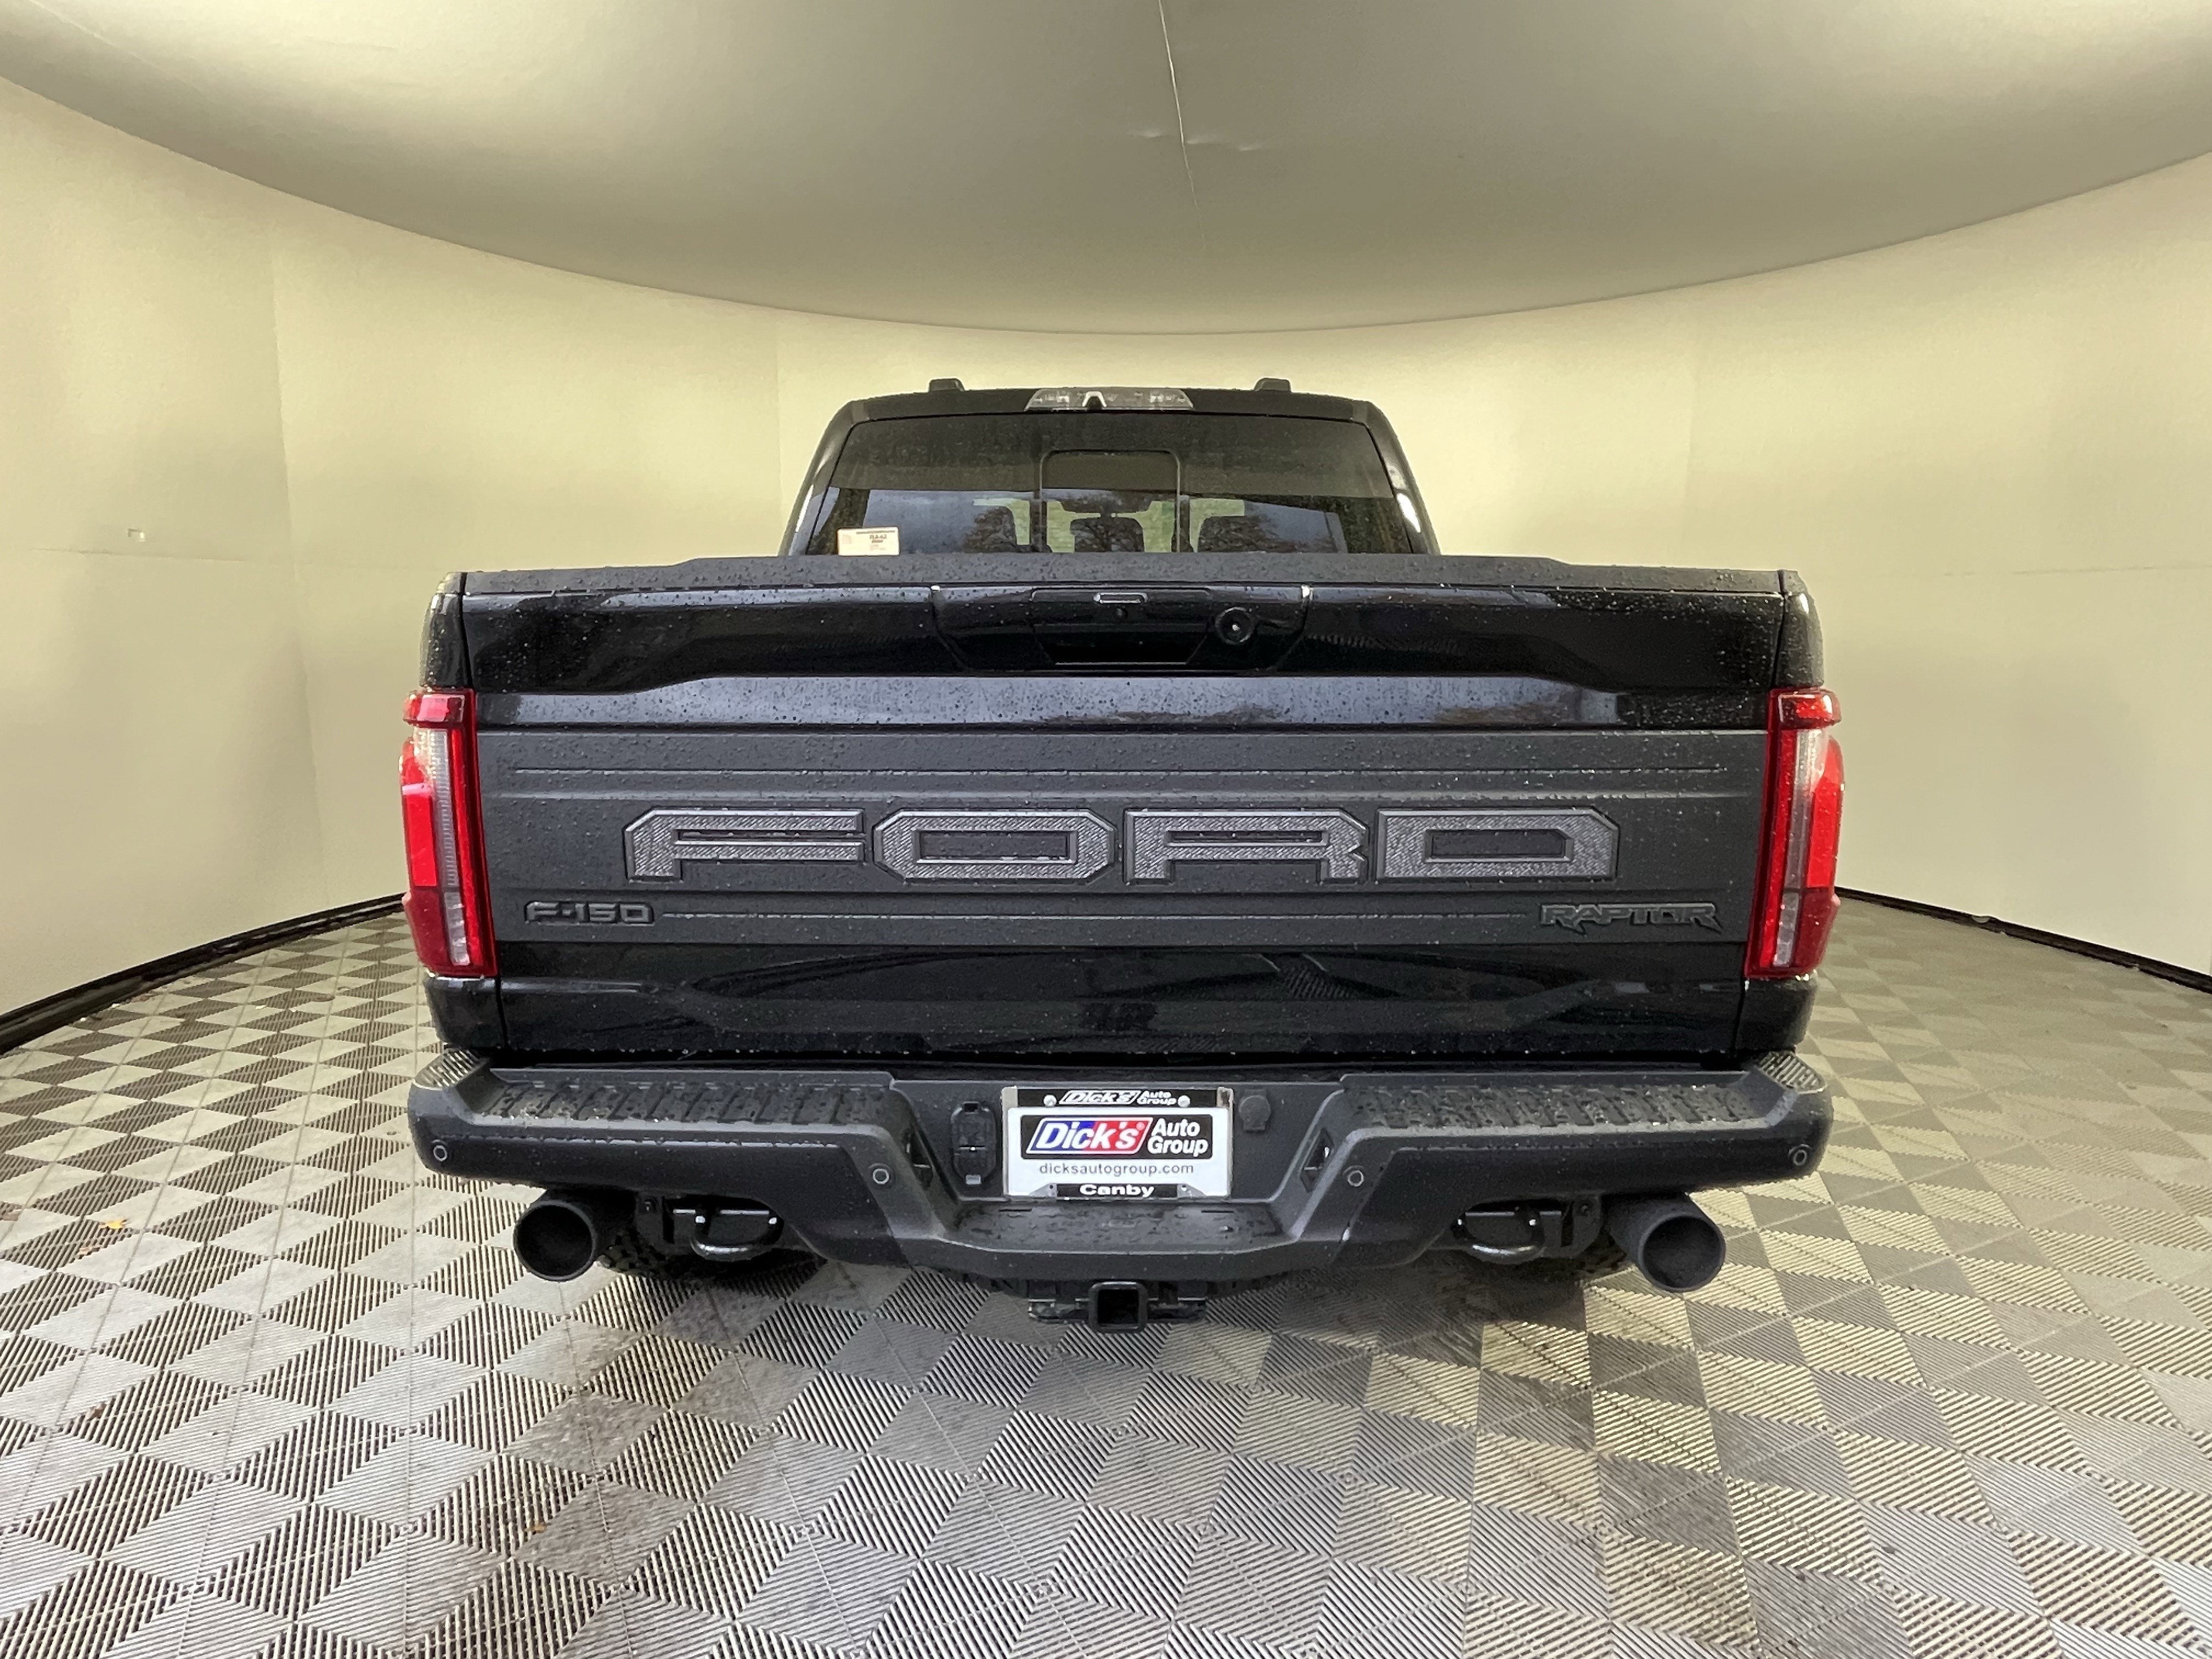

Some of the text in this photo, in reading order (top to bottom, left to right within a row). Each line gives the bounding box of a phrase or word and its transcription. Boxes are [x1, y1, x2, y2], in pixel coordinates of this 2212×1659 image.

[624, 808, 1619, 882] FORD
[525, 901, 654, 925] F-150
[1541, 903, 1723, 934] RAPTOR
[1137, 1098, 1177, 1106] Group
[1038, 1121, 1140, 1149] Dick's
[1151, 1118, 1200, 1137] Auto
[1148, 1137, 1208, 1157] Group
[1039, 1163, 1194, 1177] dicksautogroup.com
[1079, 1184, 1154, 1197] Canby
